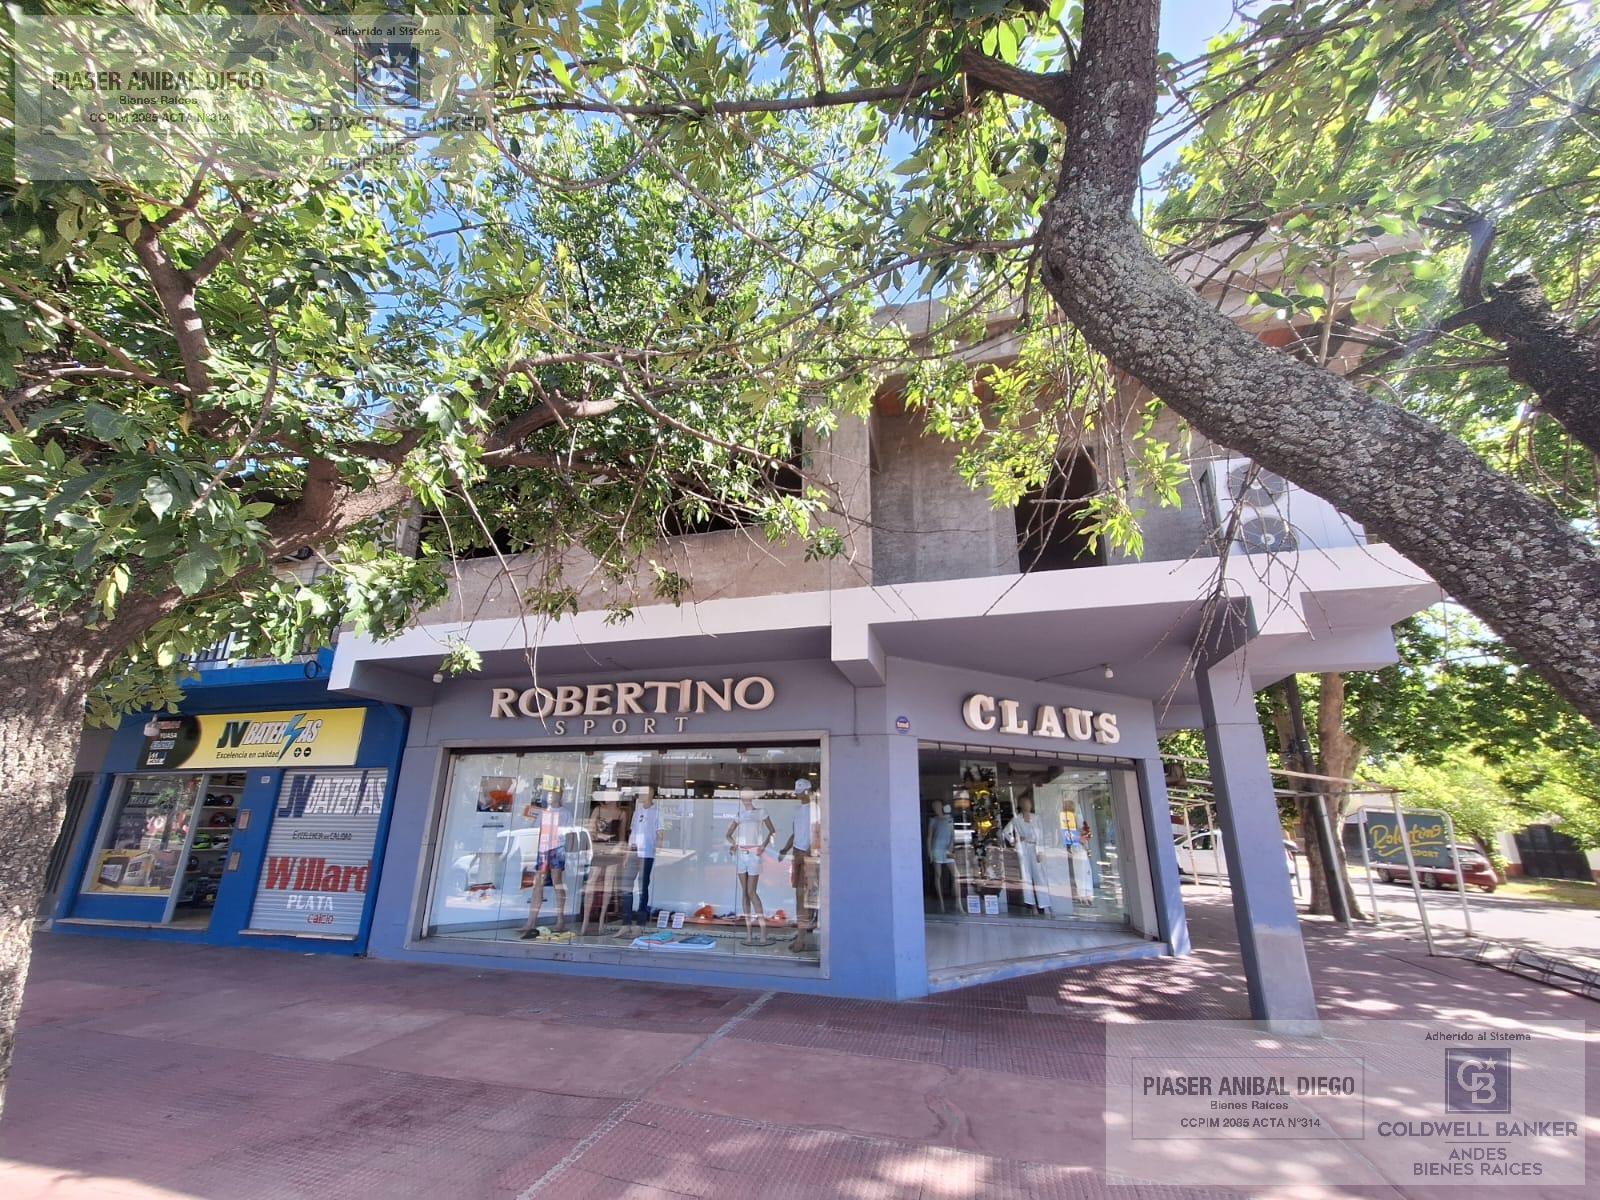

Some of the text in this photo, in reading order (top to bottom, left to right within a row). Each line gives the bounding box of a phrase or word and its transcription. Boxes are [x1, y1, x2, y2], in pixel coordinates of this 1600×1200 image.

[490, 676, 775, 718] ROBERTINO
[554, 717, 689, 736] SPORT
[963, 694, 1120, 745] CLAUS
[215, 751, 248, 760] Excelencia
[257, 751, 279, 759] calidad
[265, 856, 372, 893] Willard
[286, 894, 334, 911] PLATA
